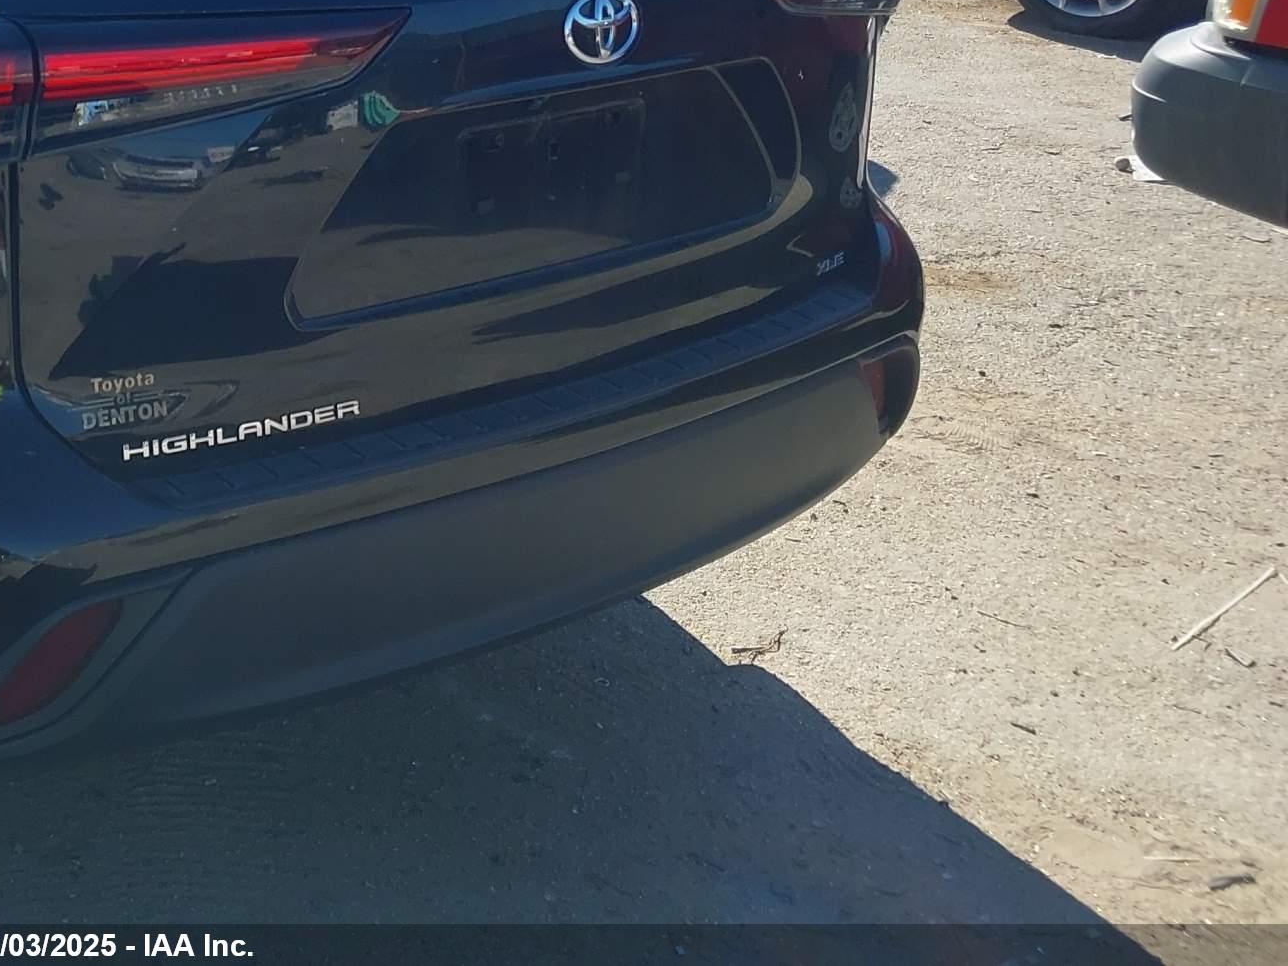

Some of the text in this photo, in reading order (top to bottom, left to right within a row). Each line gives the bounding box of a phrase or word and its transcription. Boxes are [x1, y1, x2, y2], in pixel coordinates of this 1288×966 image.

[90, 372, 155, 394] Toyota
[116, 392, 132, 405] of
[81, 401, 168, 430] DENTON
[122, 400, 361, 461] HIGHLANDER
